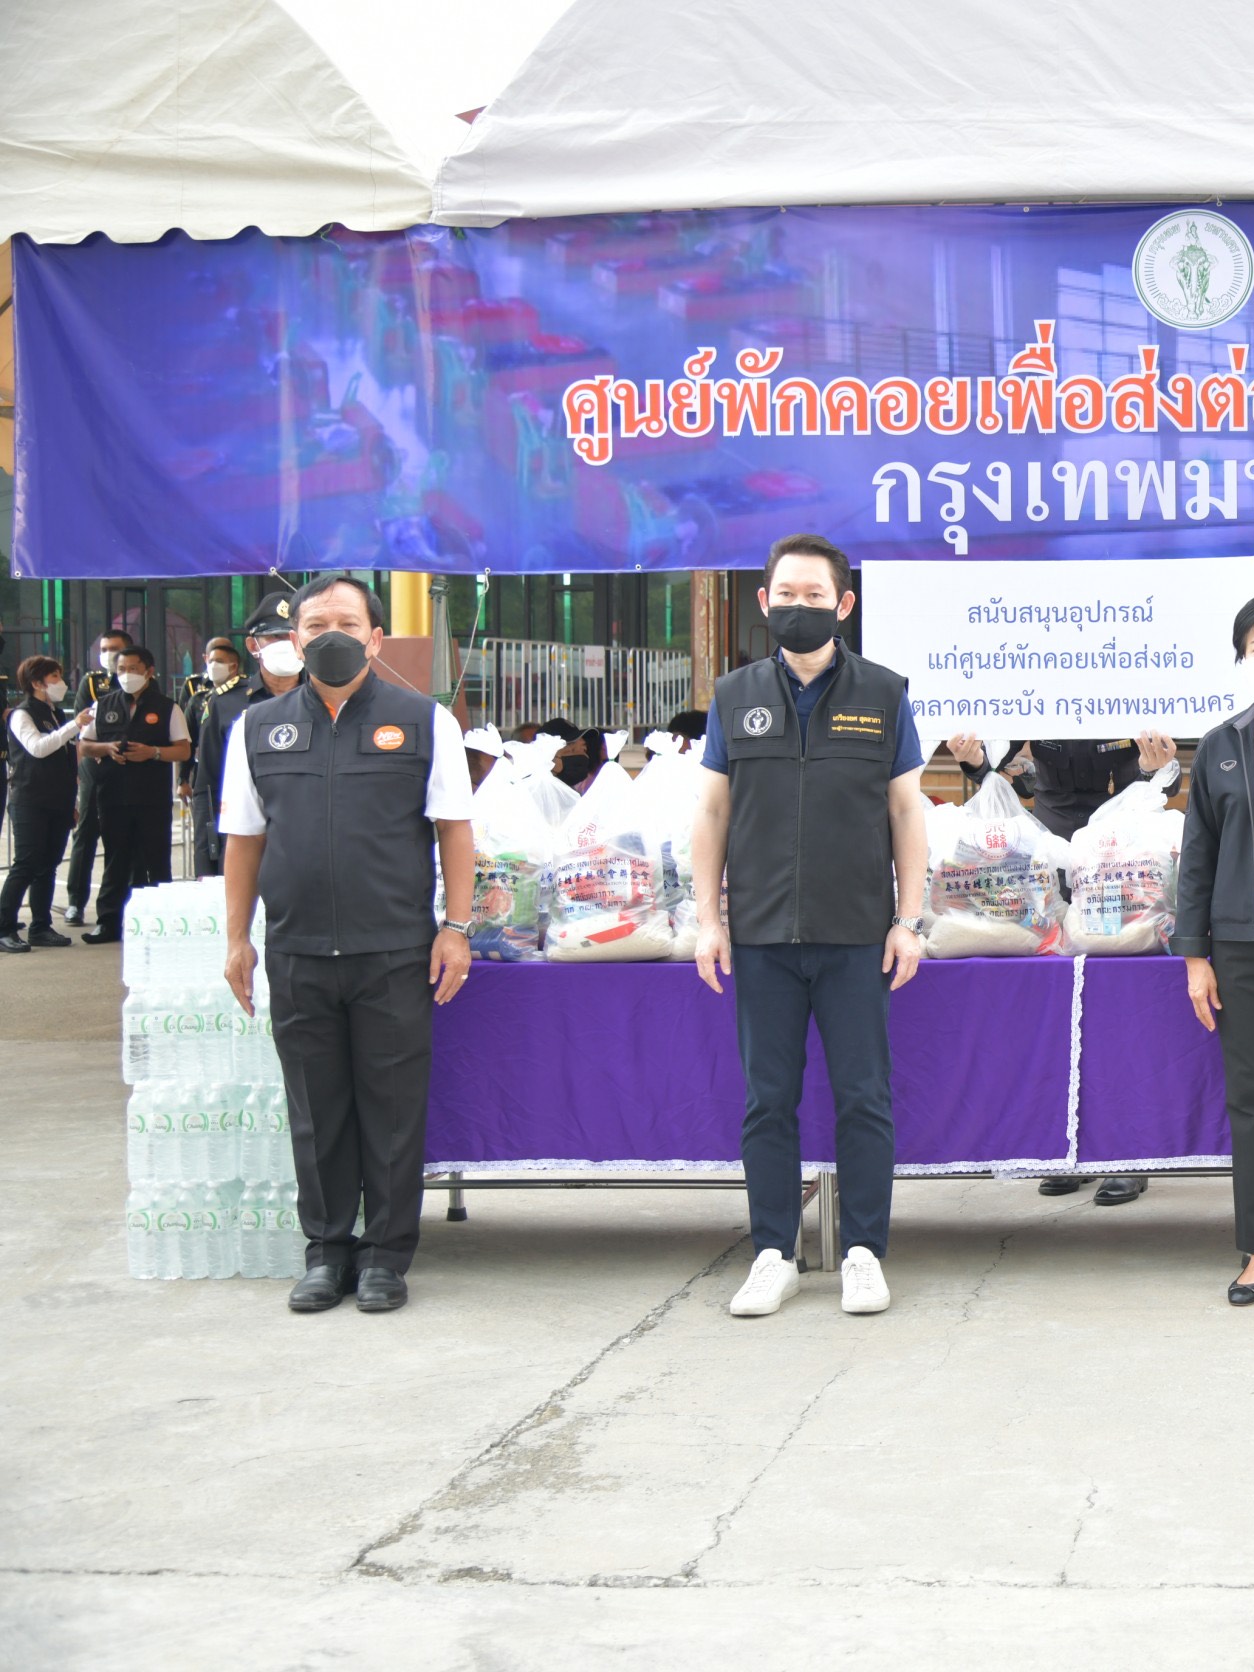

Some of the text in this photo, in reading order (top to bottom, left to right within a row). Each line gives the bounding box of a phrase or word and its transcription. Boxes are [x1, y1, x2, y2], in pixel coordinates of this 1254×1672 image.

[967, 595, 1154, 632] สนับสนุนอุปกรณ์
[928, 637, 1195, 680] แก่ศูนย์พักคอยเพื่อส่งต่อ
[1055, 691, 1235, 724] กรุงเทพมหานคร
